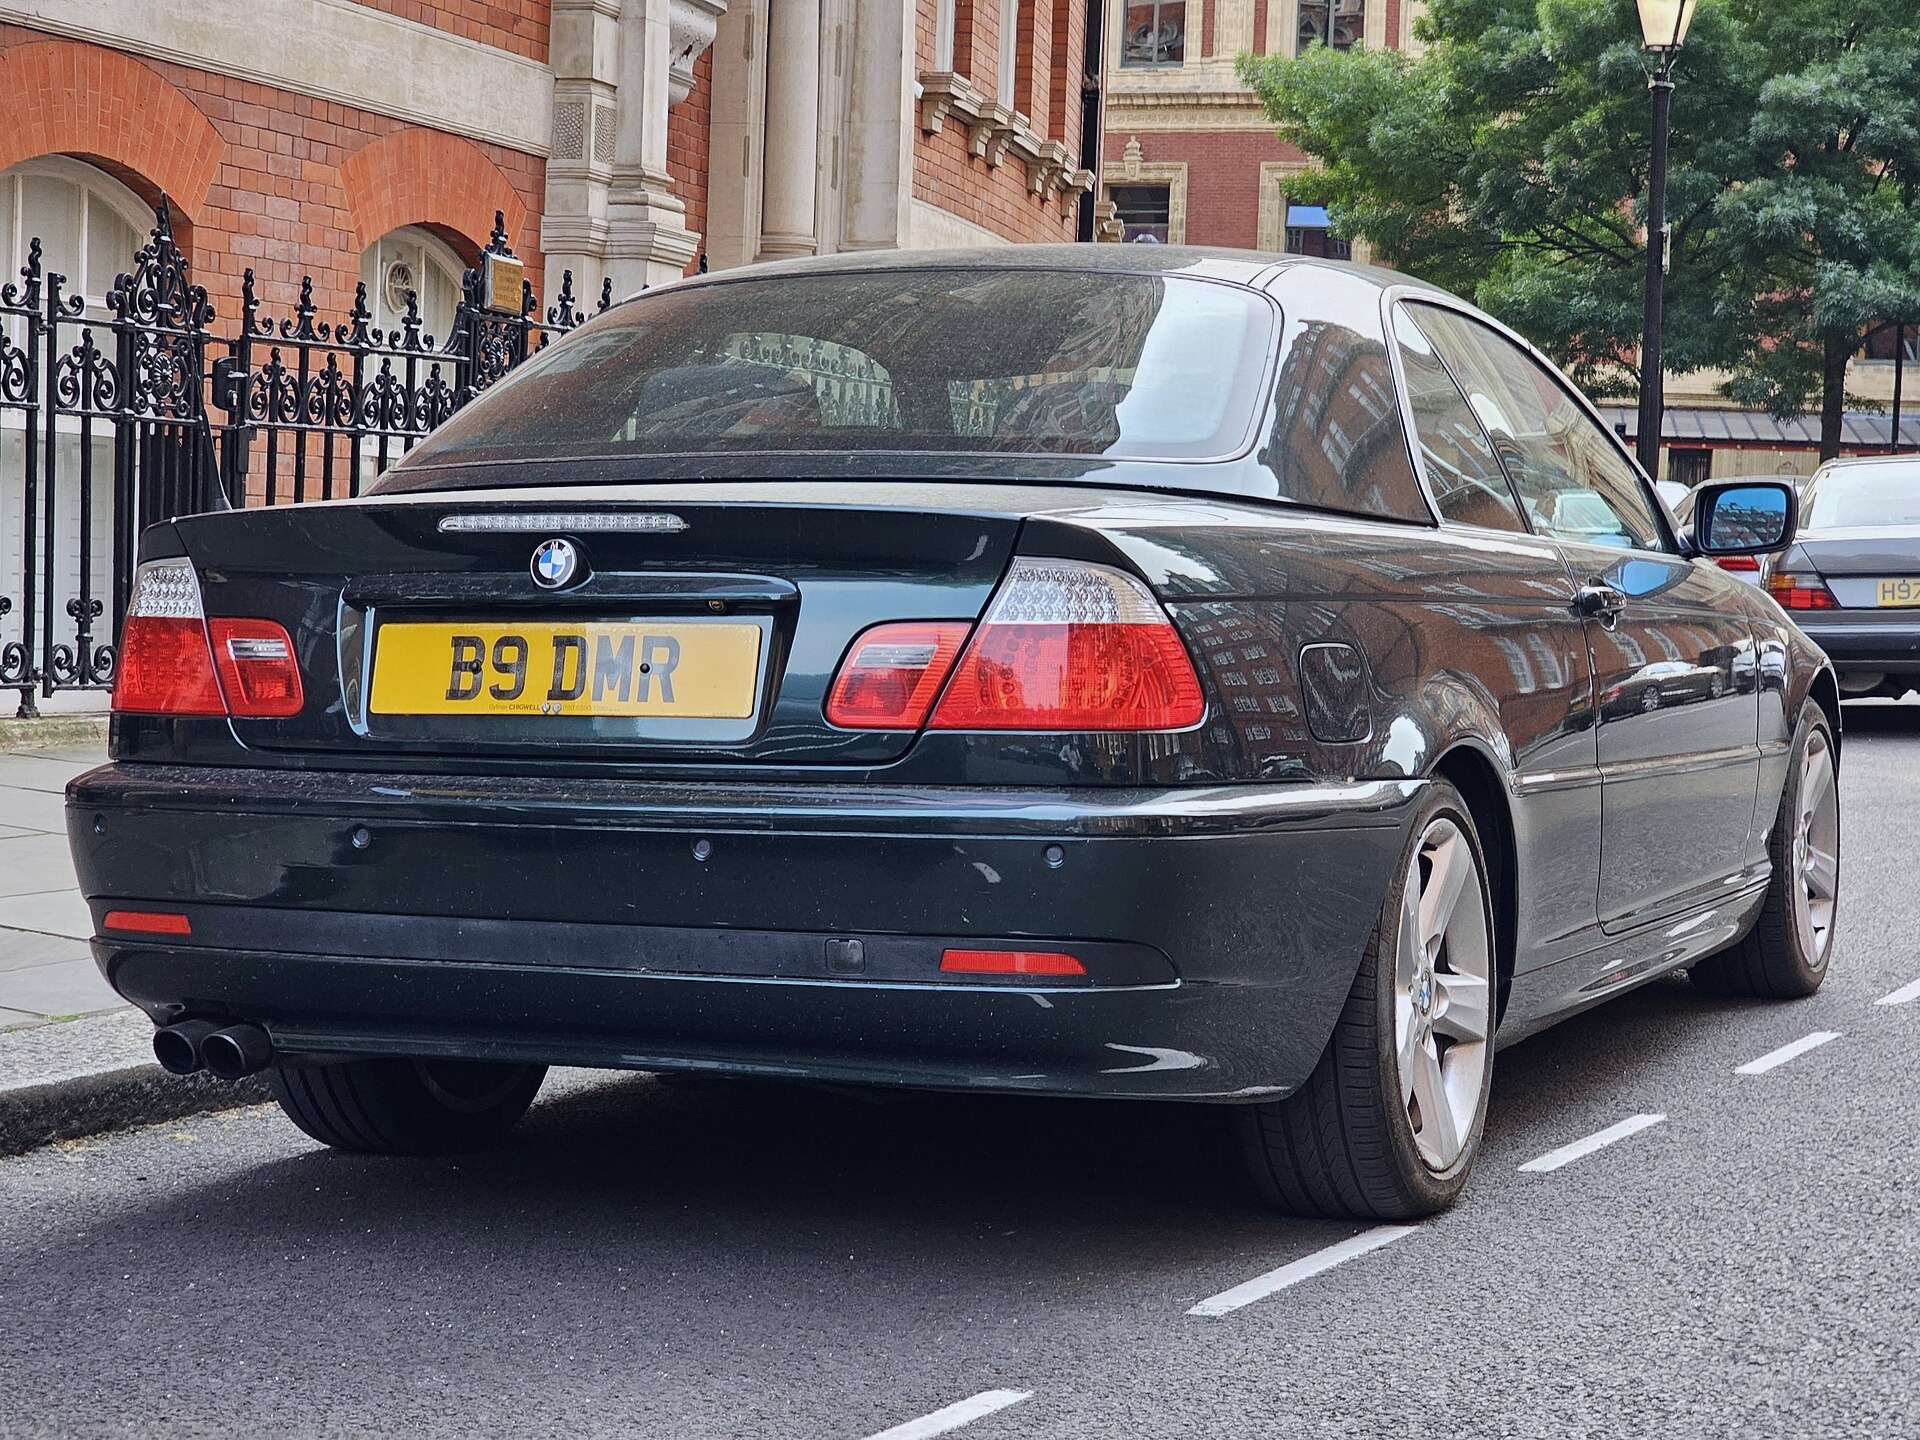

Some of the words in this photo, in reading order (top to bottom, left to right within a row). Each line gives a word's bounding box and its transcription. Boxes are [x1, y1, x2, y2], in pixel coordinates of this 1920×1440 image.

[538, 541, 571, 557] BMW
[445, 635, 529, 701] B9
[547, 635, 681, 703] DMR
